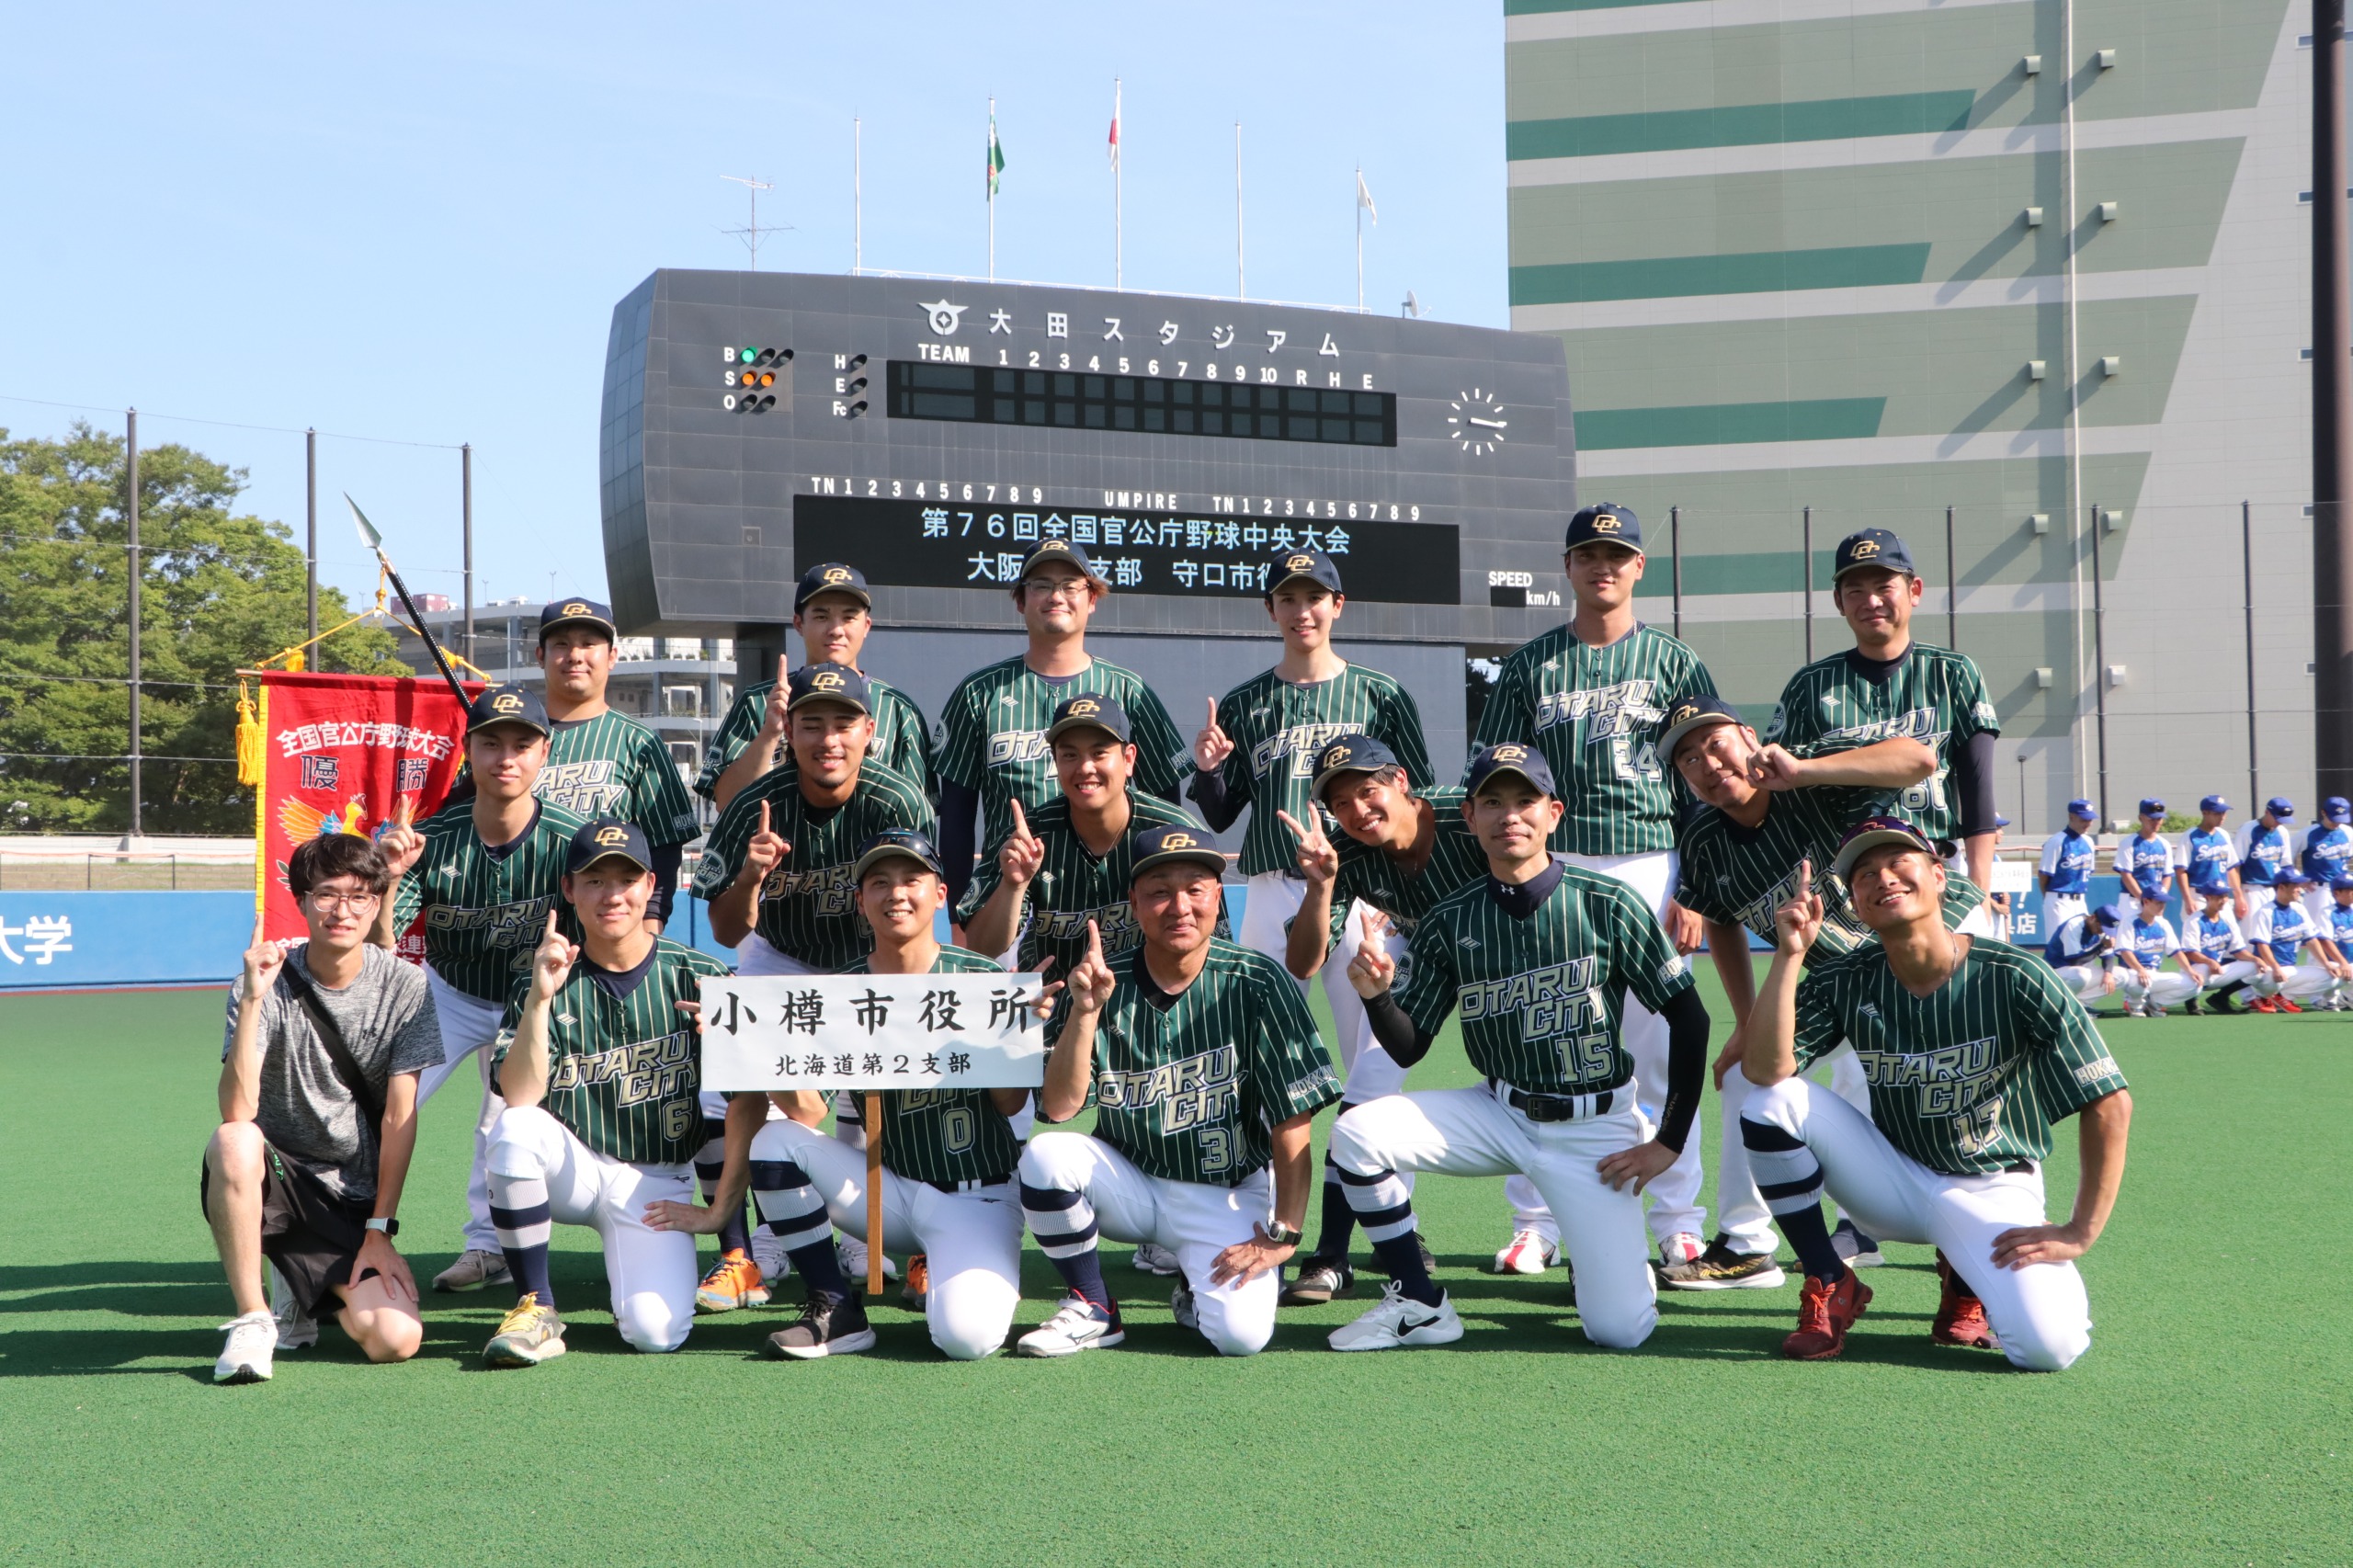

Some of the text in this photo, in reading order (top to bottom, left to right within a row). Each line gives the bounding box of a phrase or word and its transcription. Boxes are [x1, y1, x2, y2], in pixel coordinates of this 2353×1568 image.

[988, 308, 1340, 358] 大田スタジアム
[723, 347, 735, 362] B
[835, 354, 846, 369] H
[918, 343, 1373, 390] TEAM 1 2 3 4 5 6 7 8 9 10 R H E
[724, 370, 735, 386] S
[835, 378, 846, 392] E
[833, 401, 847, 416] Fc
[811, 477, 1042, 504] TN 1 2 3 4 5 6 7 8 9
[1105, 490, 1177, 510] UMPIRE
[1212, 495, 1420, 521] TN 1 2 3 4 5 6 7 8 9
[1488, 571, 1533, 587] SPEED
[1526, 589, 1561, 606] km/h
[1535, 680, 1655, 734] OTARU
[276, 721, 456, 762] 全国官公庁野球大会
[1612, 739, 1663, 781] 24
[1456, 955, 1594, 1022] OTARU
[710, 986, 1033, 1037] 小樽市役所
[1523, 985, 1607, 1042] CITY
[551, 1029, 689, 1092] OTARU
[774, 1051, 972, 1077] 北海道第2支部
[1097, 1042, 1235, 1110] OTARU
[1554, 1030, 1615, 1085] 15
[662, 1096, 693, 1142] 6
[1953, 1094, 2005, 1159] 17
